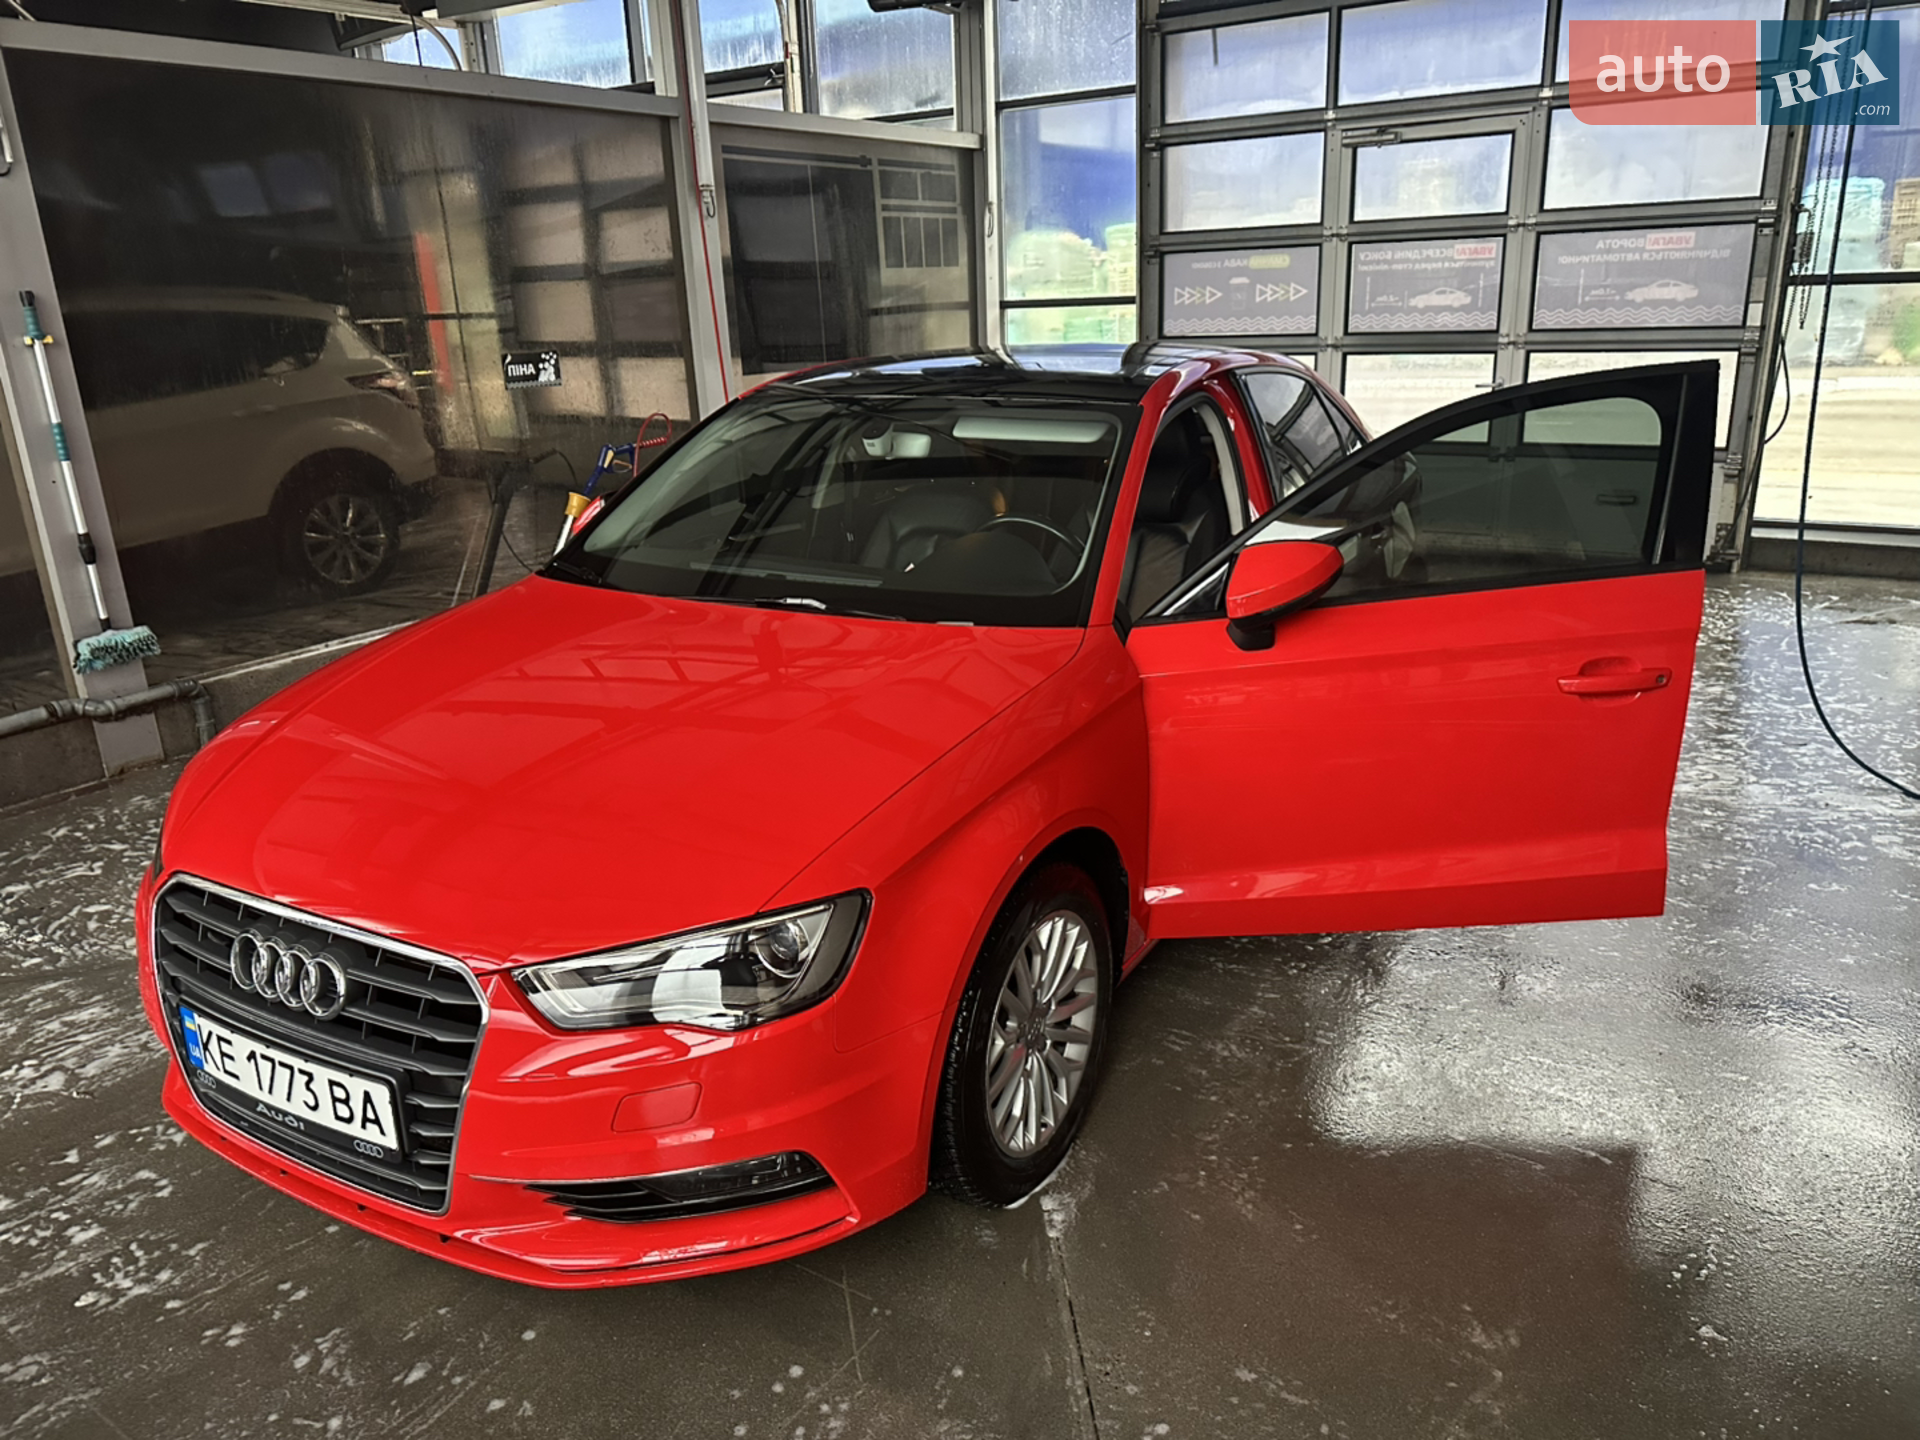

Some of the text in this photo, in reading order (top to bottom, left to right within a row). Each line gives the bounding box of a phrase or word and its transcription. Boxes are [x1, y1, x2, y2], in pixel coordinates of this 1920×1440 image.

[508, 363, 536, 377] ПІНА
[188, 1042, 203, 1060] UA
[198, 1024, 387, 1137] KE 1773 BA
